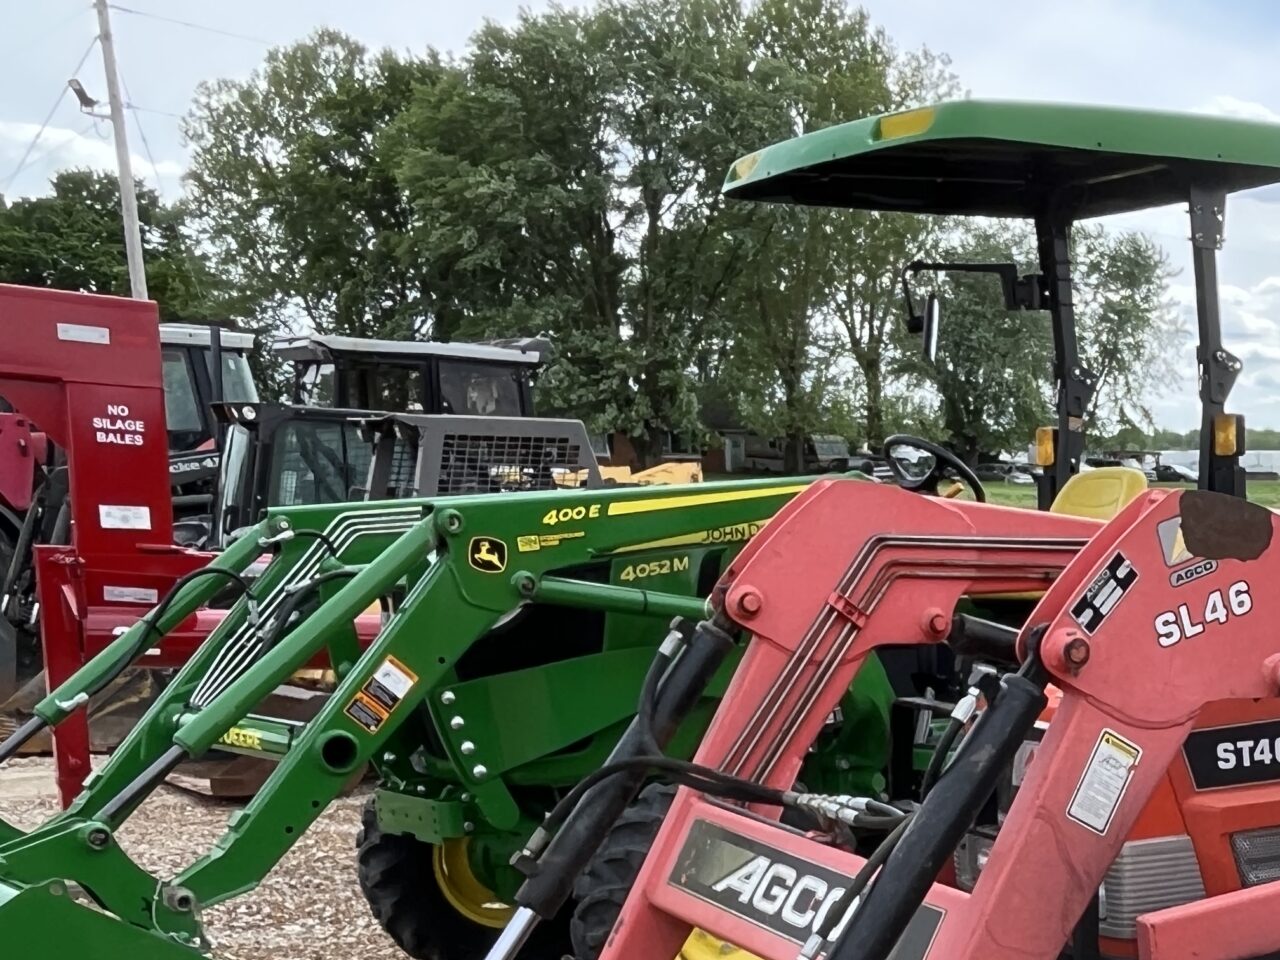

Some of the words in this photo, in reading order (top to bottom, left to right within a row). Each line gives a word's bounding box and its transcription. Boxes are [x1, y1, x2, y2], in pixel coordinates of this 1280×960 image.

[107, 404, 129, 416] NO
[92, 417, 145, 431] SILAGE
[96, 432, 144, 445] BALES
[542, 506, 585, 526] 400
[589, 504, 601, 518] E
[701, 527, 746, 541] JOHN
[620, 559, 670, 582] 4052
[673, 556, 689, 572] M
[1175, 561, 1213, 584] AGCO
[1154, 579, 1253, 648] SL46
